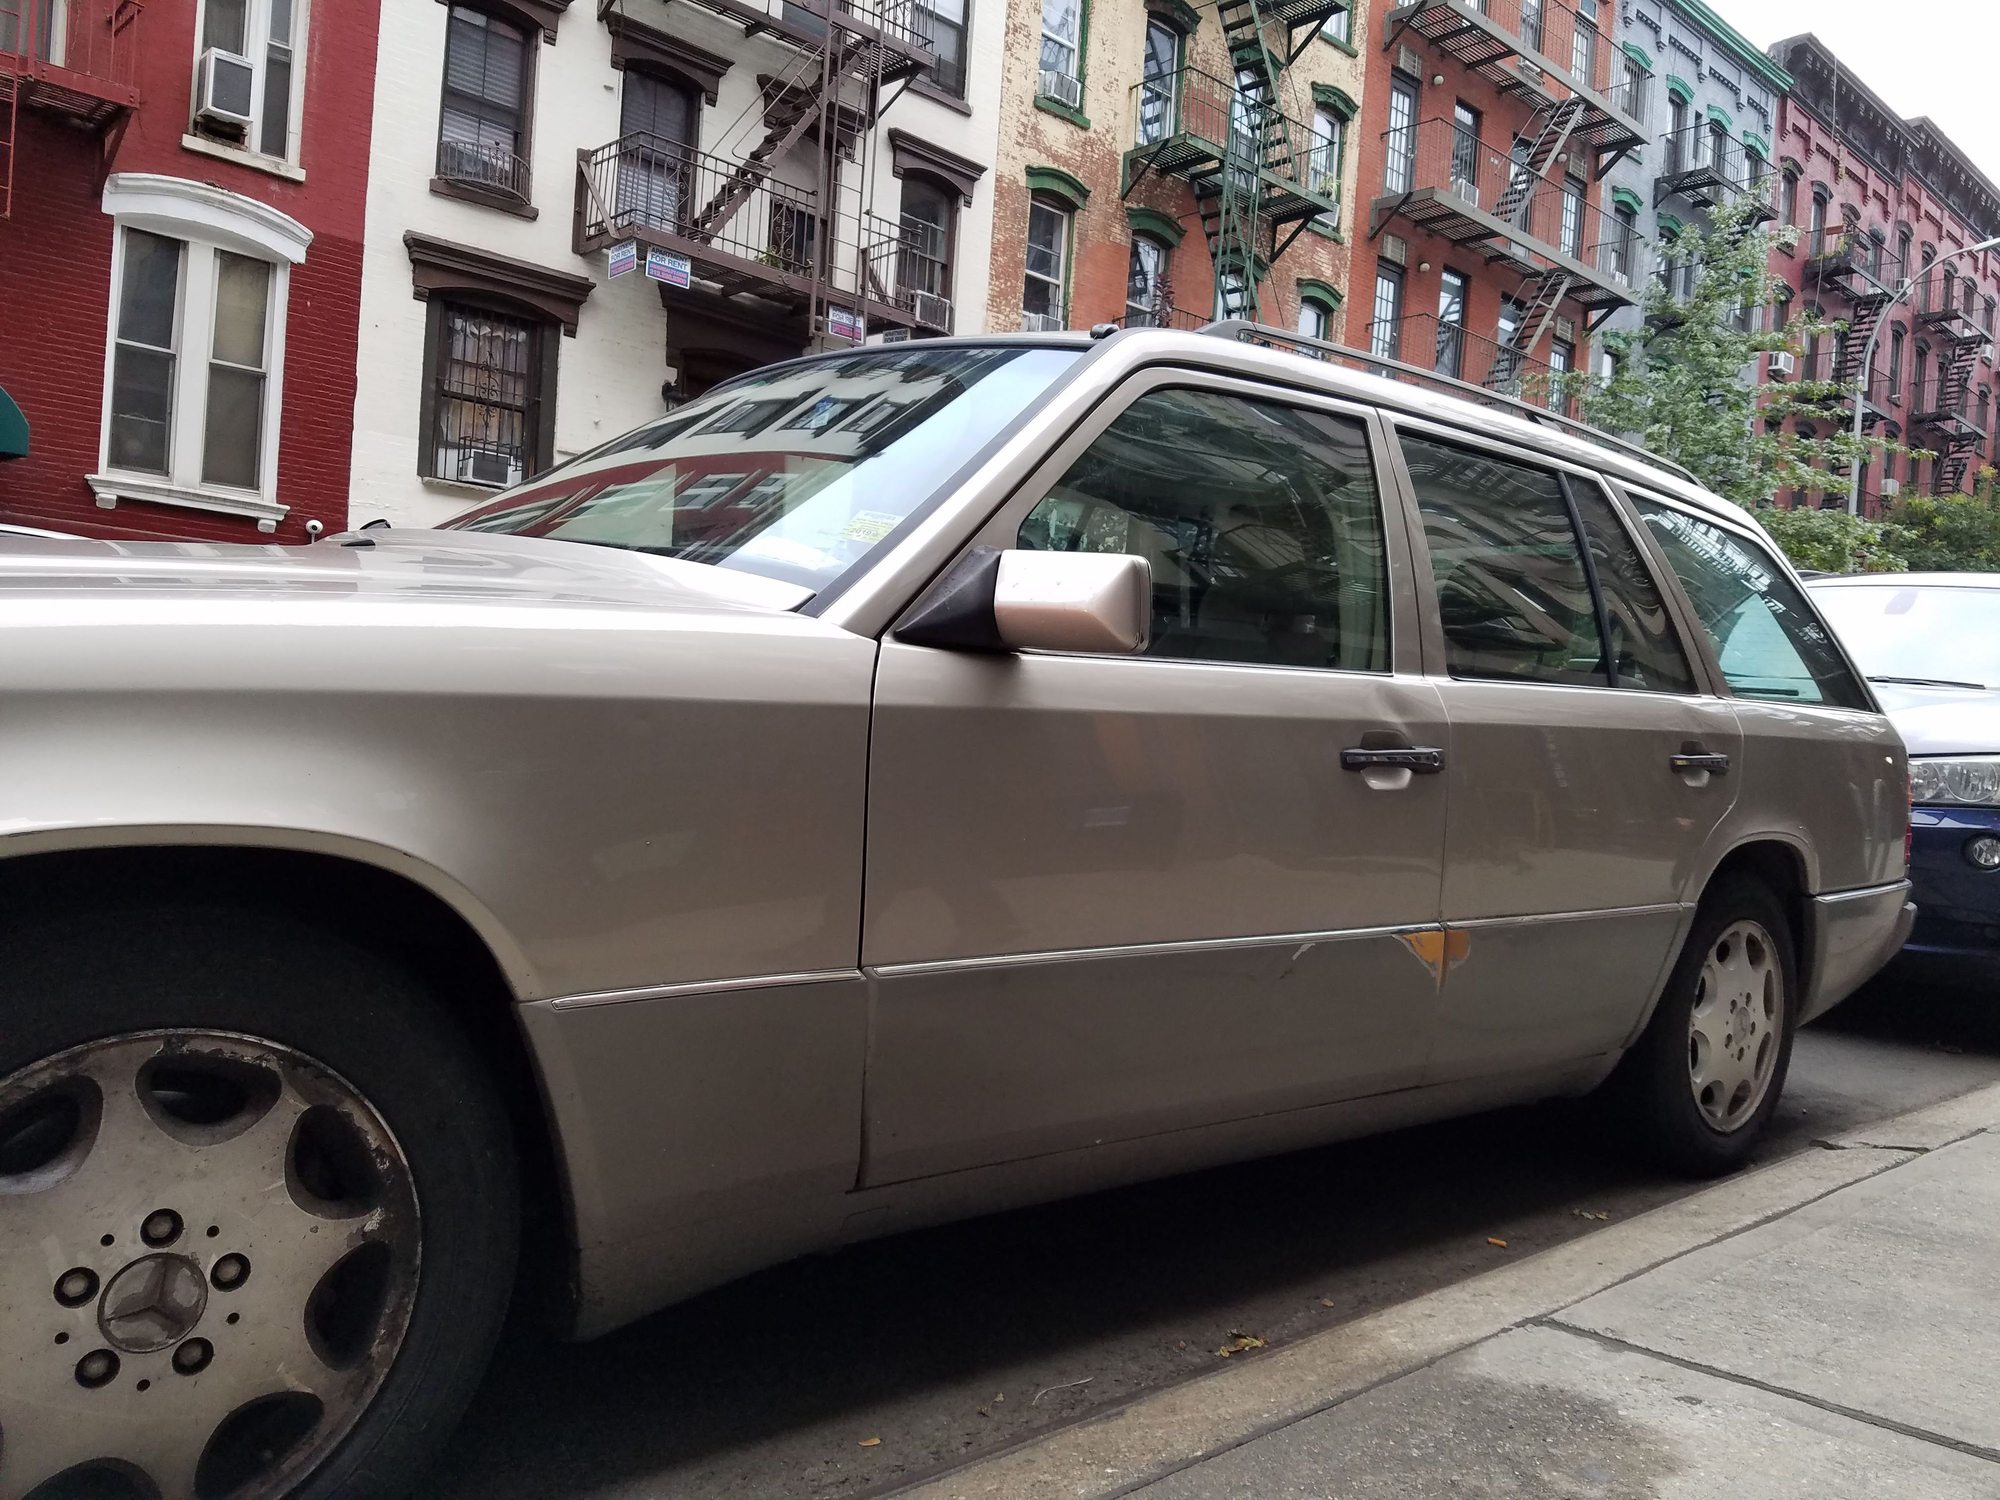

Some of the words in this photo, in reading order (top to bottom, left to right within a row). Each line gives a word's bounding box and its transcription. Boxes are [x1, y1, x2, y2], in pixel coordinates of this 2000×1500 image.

[651, 246, 687, 263] APARTMENT
[651, 254, 666, 264] FOR
[667, 259, 688, 271] RENT
[832, 312, 845, 321] FOR
[845, 315, 861, 326] RET
